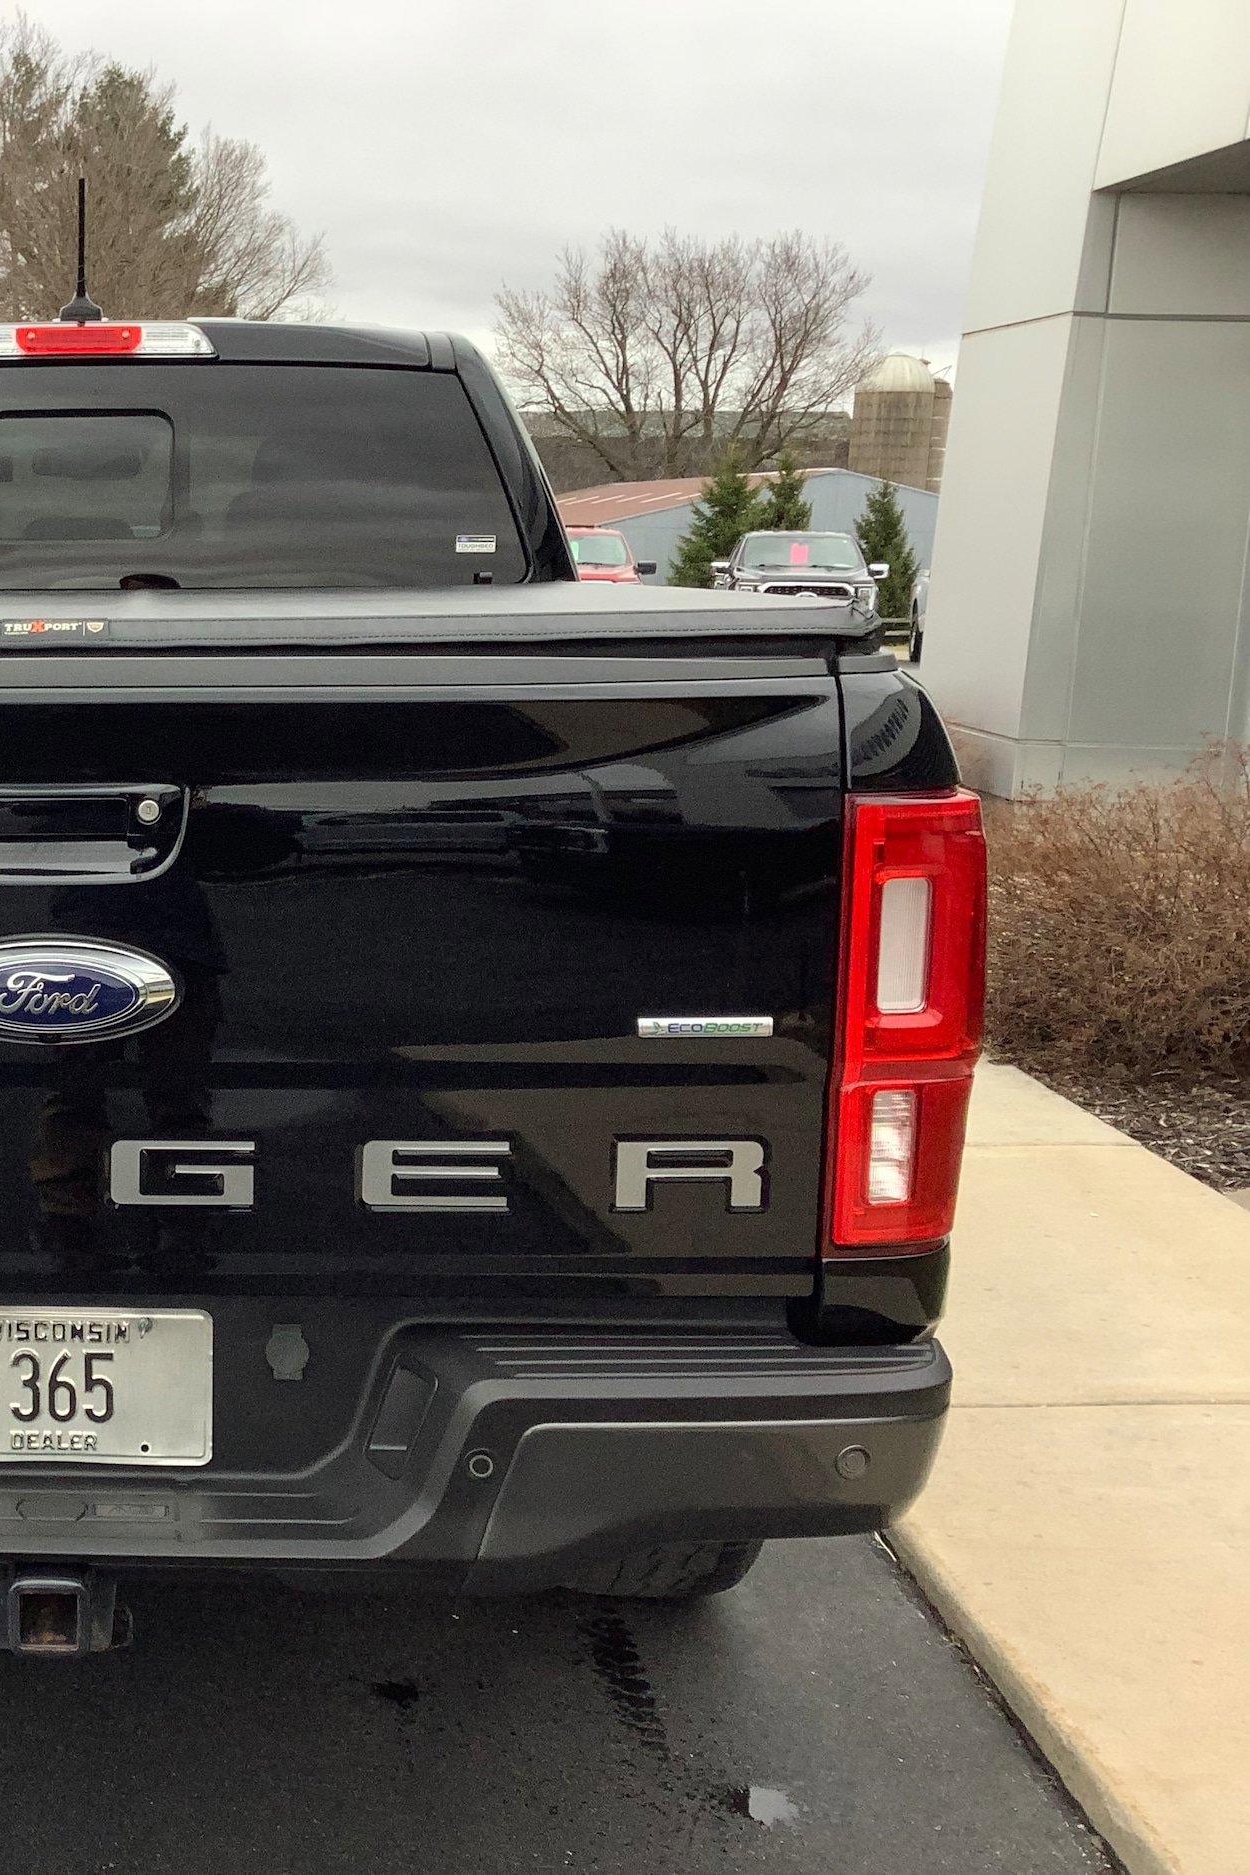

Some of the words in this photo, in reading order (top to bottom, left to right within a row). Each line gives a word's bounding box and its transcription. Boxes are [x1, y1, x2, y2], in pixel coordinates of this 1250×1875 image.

[4, 620, 79, 633] TRUXPORT
[667, 1023, 763, 1033] ECOBOOST
[9, 1348, 116, 1424] 365
[9, 1430, 98, 1452] DEALER
